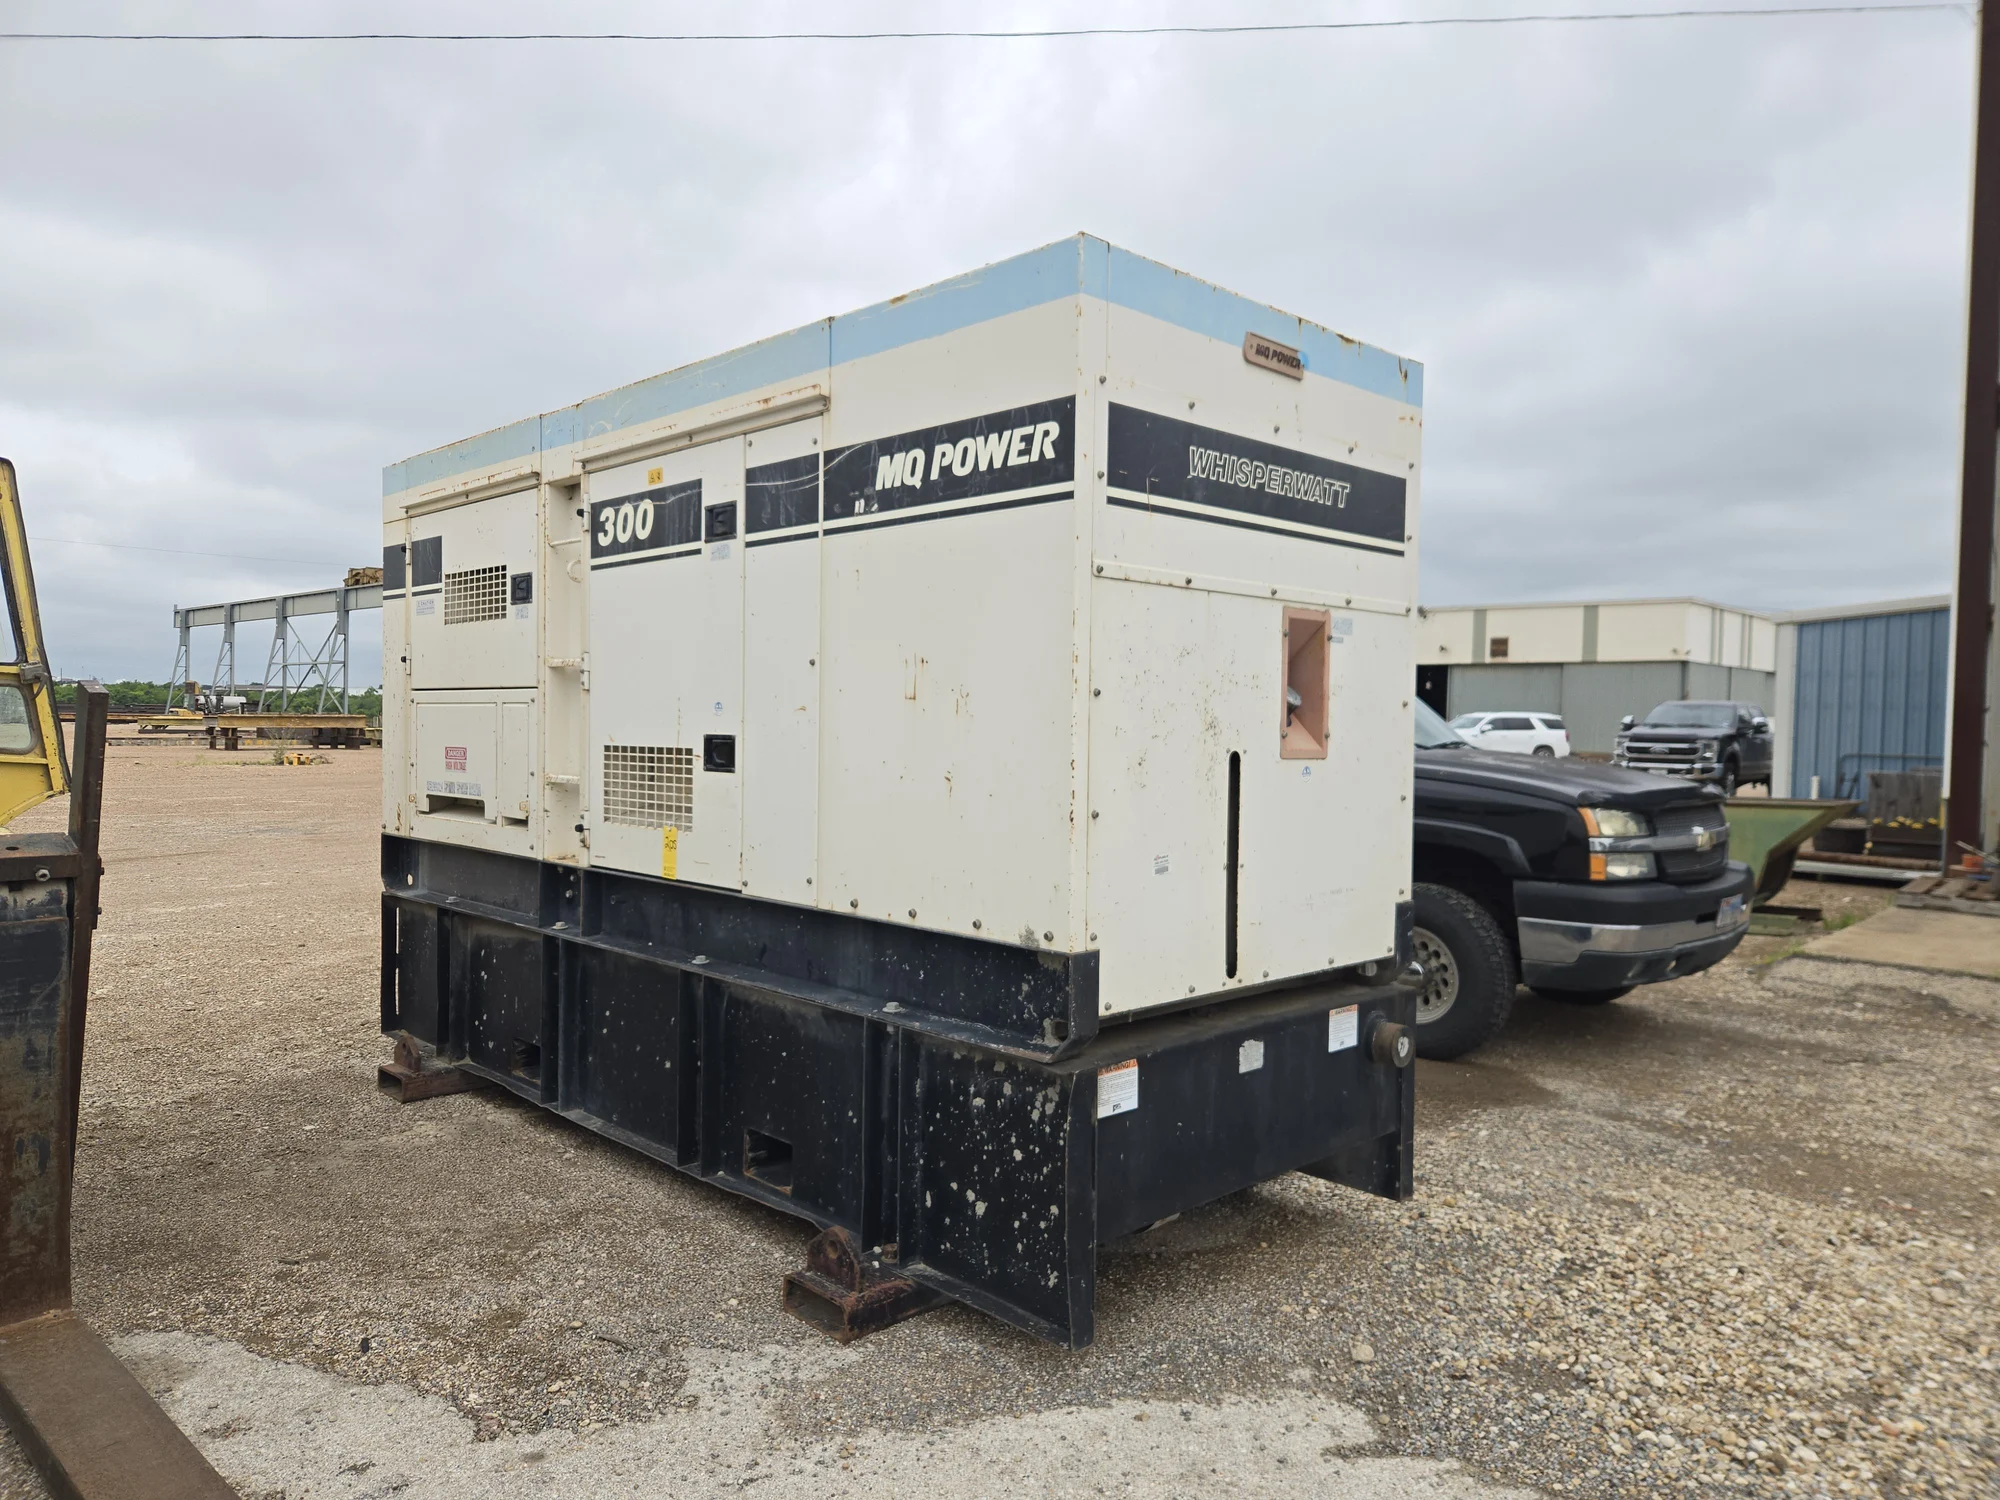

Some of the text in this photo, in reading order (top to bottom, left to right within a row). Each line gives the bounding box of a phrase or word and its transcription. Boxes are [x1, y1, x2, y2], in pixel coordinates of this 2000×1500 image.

[1255, 343, 1302, 371] MQ POWER
[875, 420, 1060, 491] MQ POWER
[1189, 446, 1351, 508] WHISPERWATT
[597, 498, 655, 547] 300
